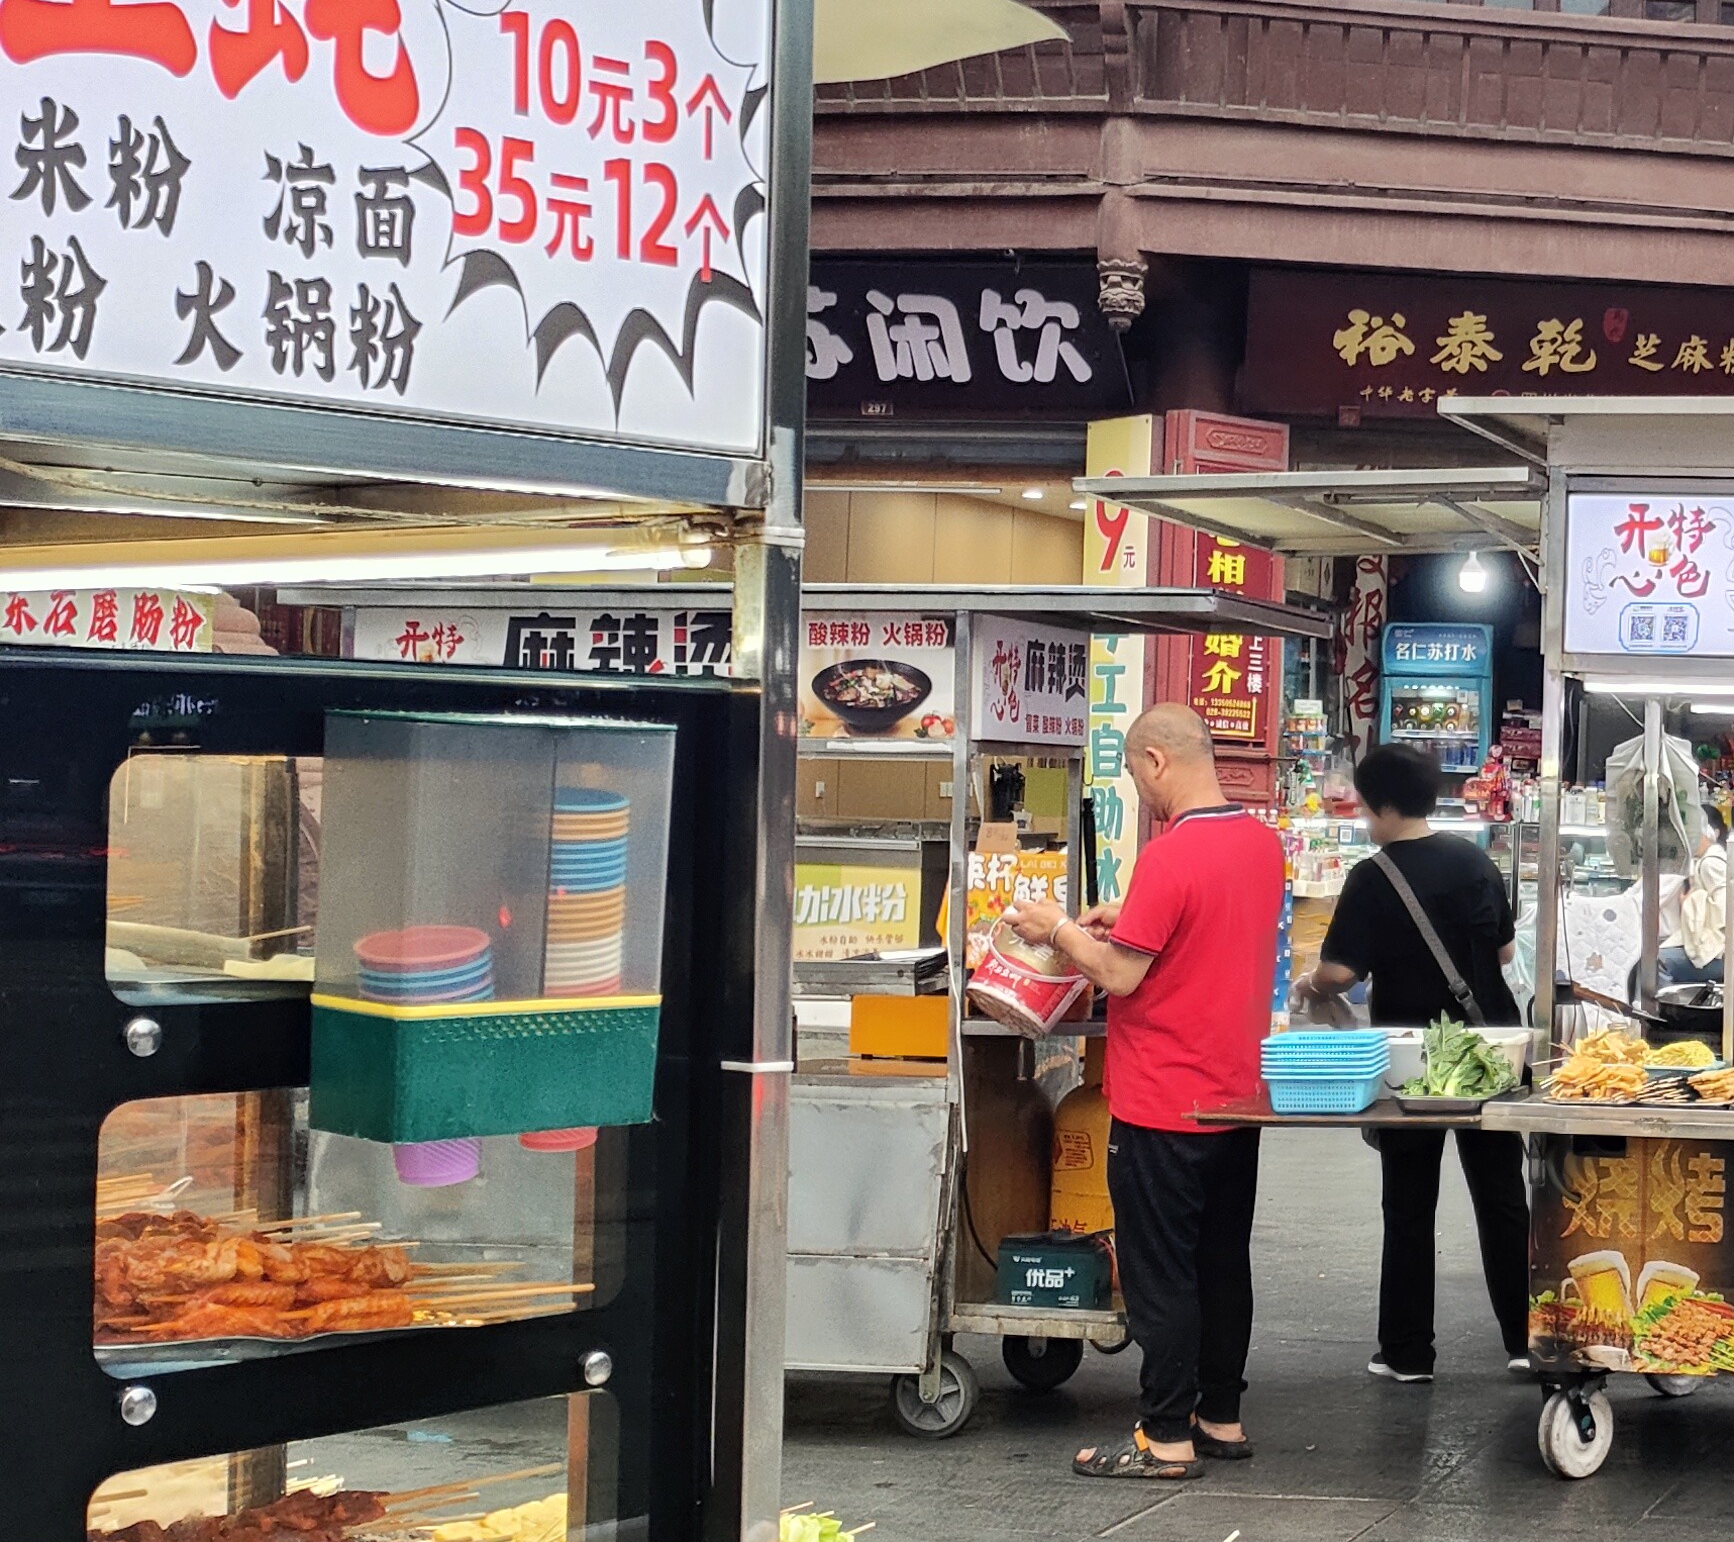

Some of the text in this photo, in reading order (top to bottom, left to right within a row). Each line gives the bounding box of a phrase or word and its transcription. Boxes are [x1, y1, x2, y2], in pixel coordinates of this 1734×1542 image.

[499, 11, 732, 161] 10元3个
[9, 96, 418, 268] 米粉 凉面
[452, 127, 731, 283] 35元12个
[0, 234, 424, 396] 粉 火锅粉
[867, 403, 887, 414] 297
[808, 621, 946, 647] 酸辣粉 火锅粉
[1024, 638, 1087, 703] 麻辣烫
[1395, 642, 1477, 662] 名仁苏打水
